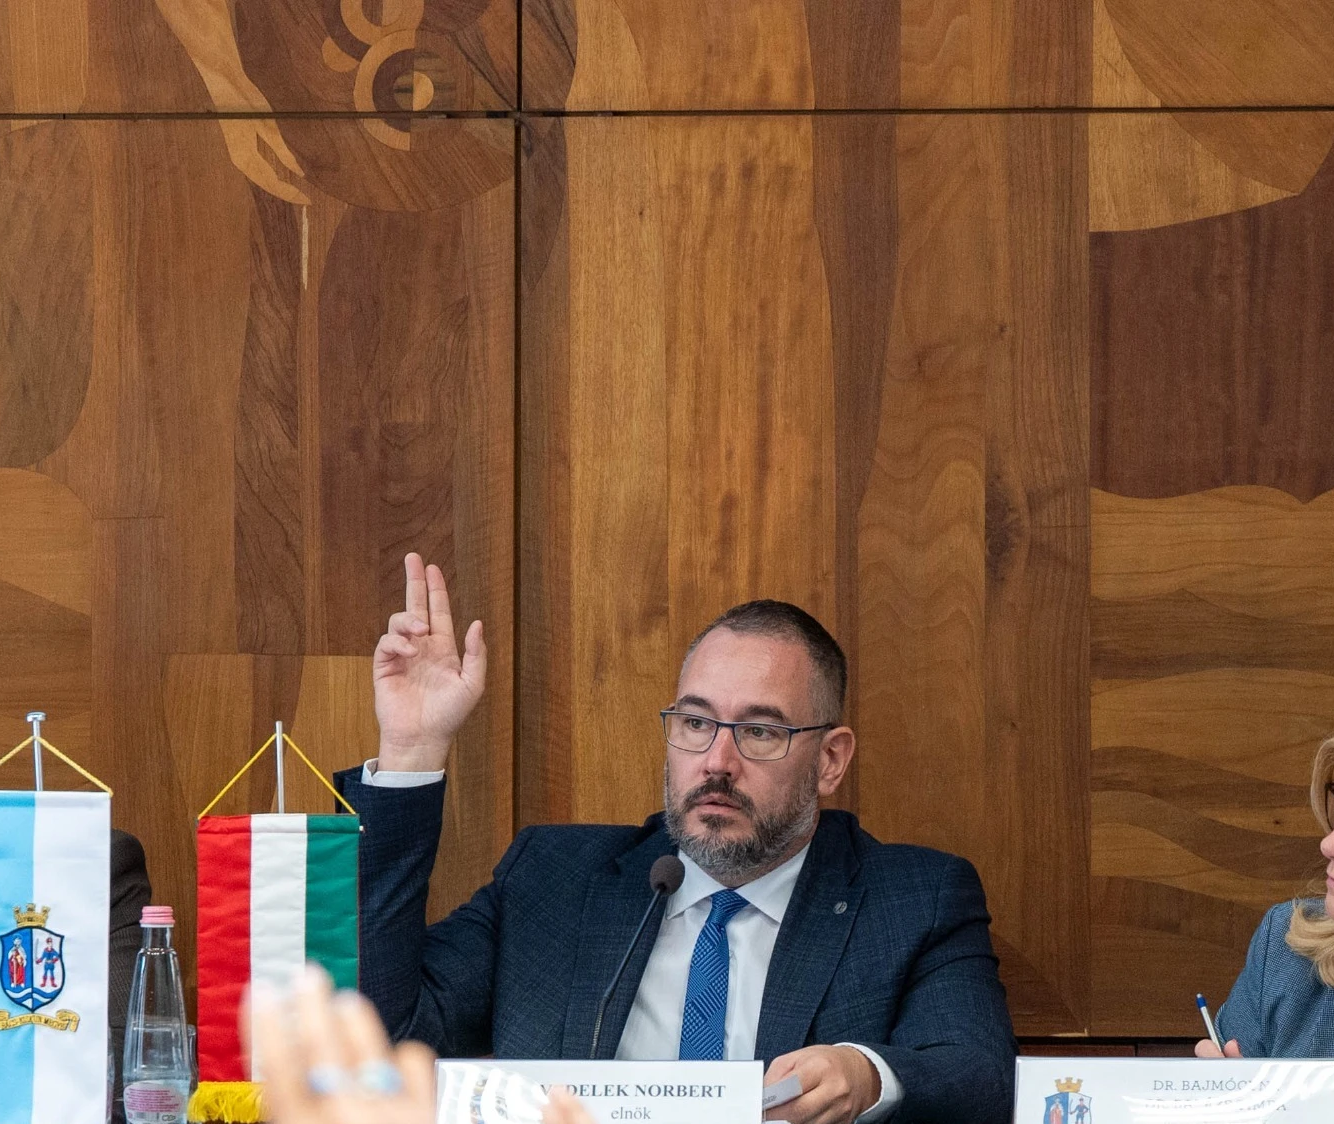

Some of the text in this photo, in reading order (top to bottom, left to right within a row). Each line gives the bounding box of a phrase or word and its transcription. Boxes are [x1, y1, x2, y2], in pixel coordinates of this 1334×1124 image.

[540, 1084, 727, 1098] VDELEK NORBERT
[1153, 1079, 1177, 1091] DR.
[610, 1106, 652, 1120] elnök
